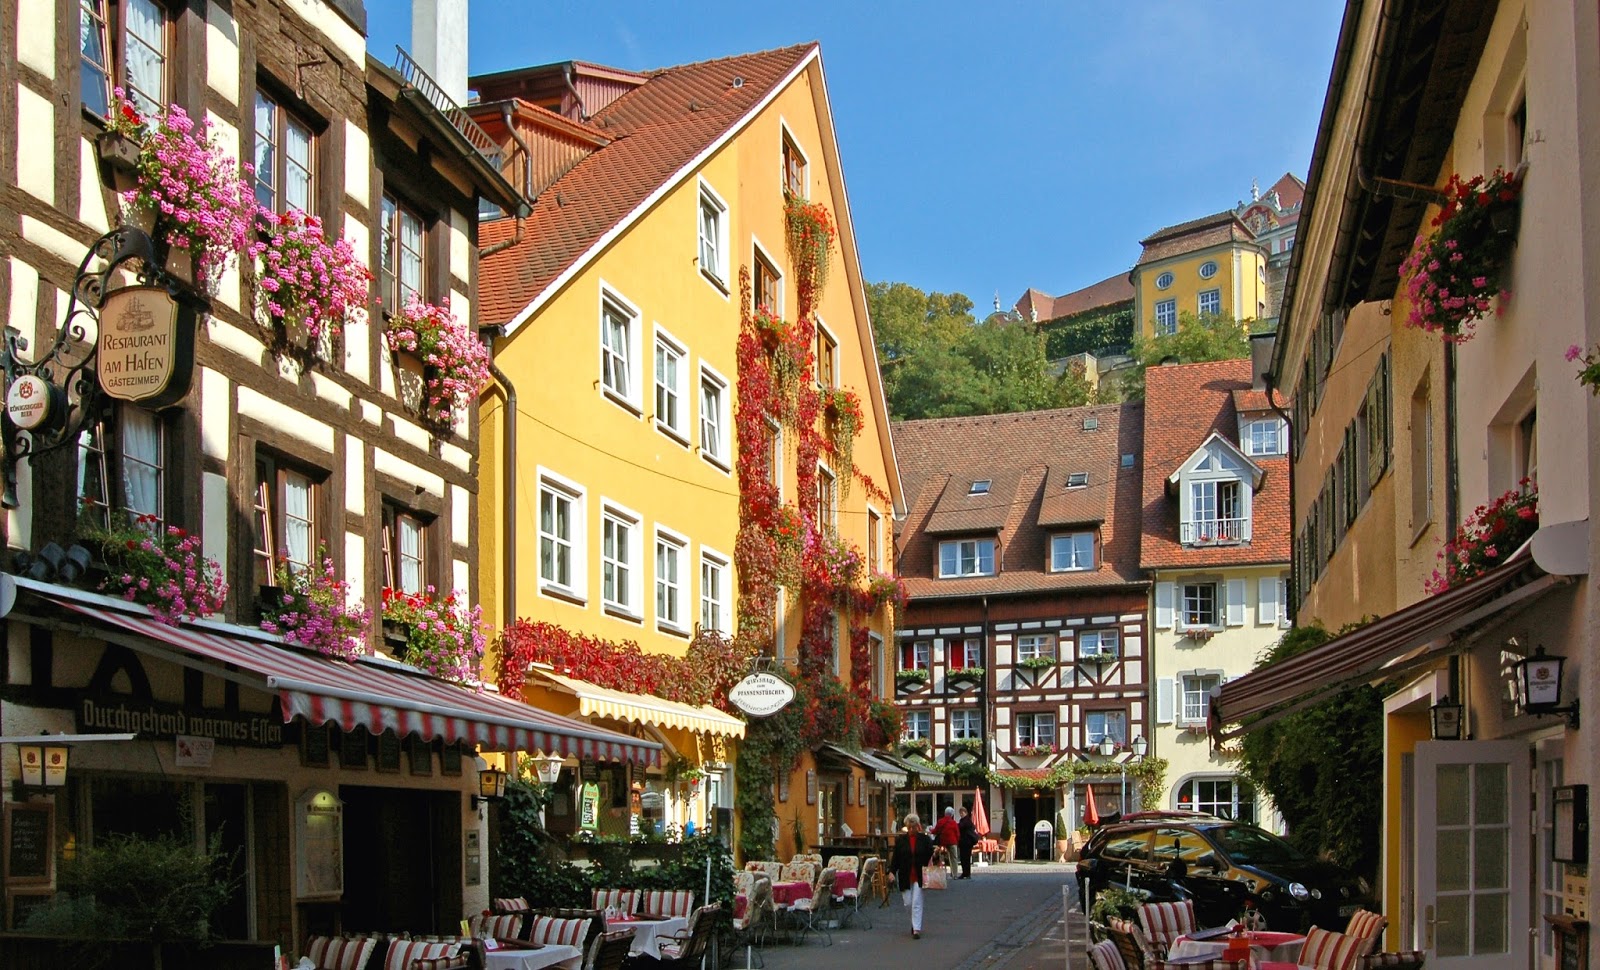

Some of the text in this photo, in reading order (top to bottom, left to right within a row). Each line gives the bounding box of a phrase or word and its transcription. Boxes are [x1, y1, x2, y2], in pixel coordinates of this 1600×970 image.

[103, 333, 168, 350] RESTAURANT
[104, 359, 121, 374] AM
[109, 375, 160, 388] GÄSTEZIMMER
[83, 698, 186, 735] Durchgehend
[190, 717, 247, 740] warmes
